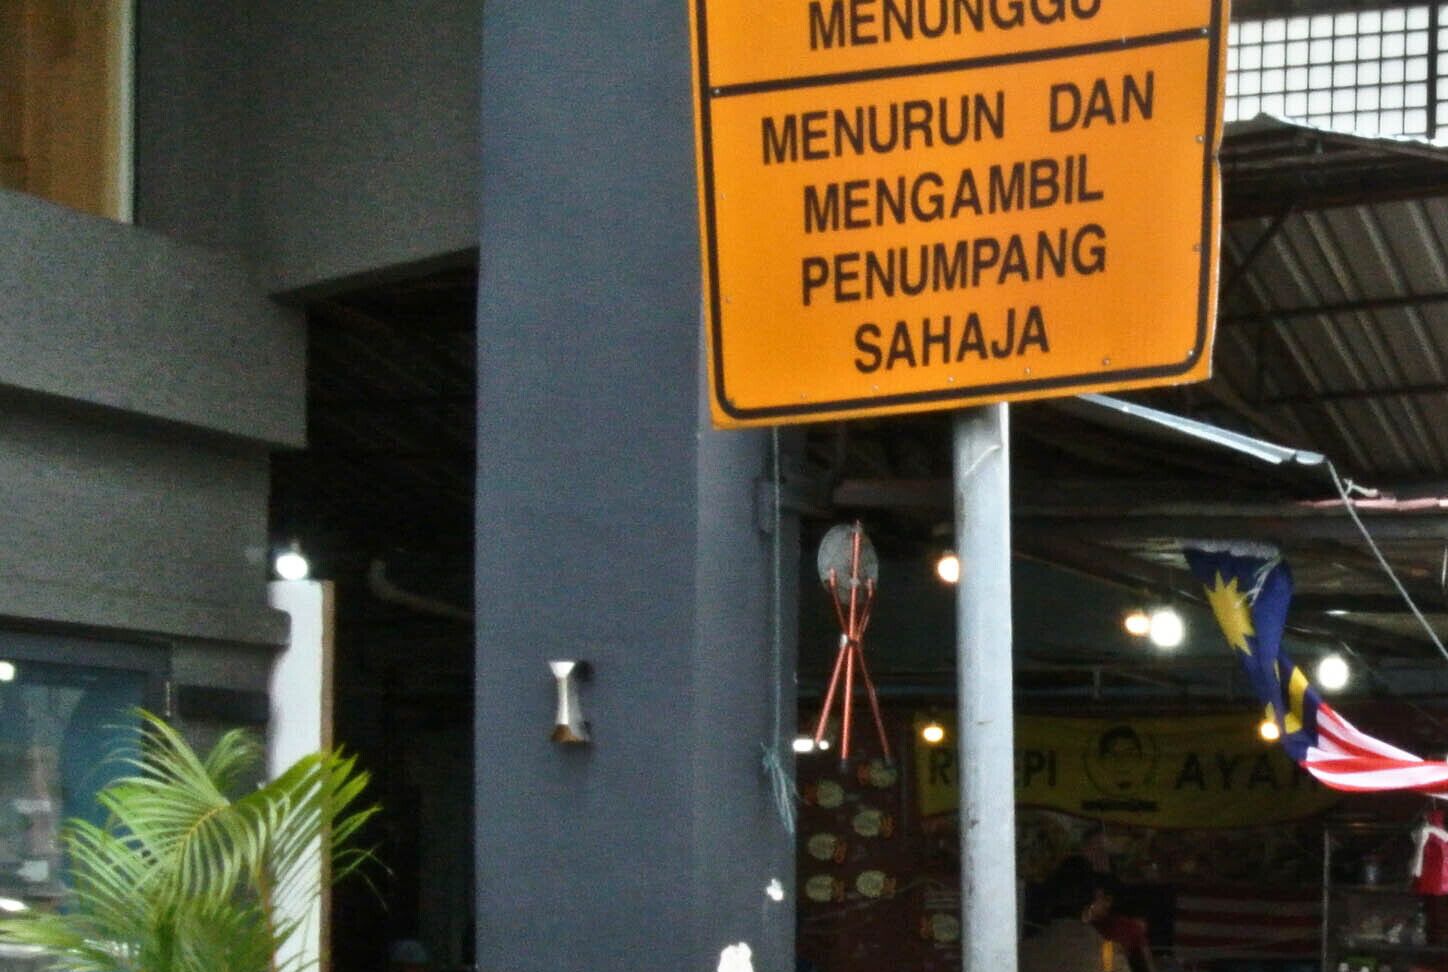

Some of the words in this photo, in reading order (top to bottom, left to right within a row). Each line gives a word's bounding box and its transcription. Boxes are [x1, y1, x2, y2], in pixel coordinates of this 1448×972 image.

[762, 92, 1005, 165] MENURUN
[1050, 72, 1156, 132] DAN
[804, 155, 1104, 234] MENGAMBIL
[803, 224, 1108, 306] PENUMPANG
[855, 306, 1050, 374] SAHAJA
